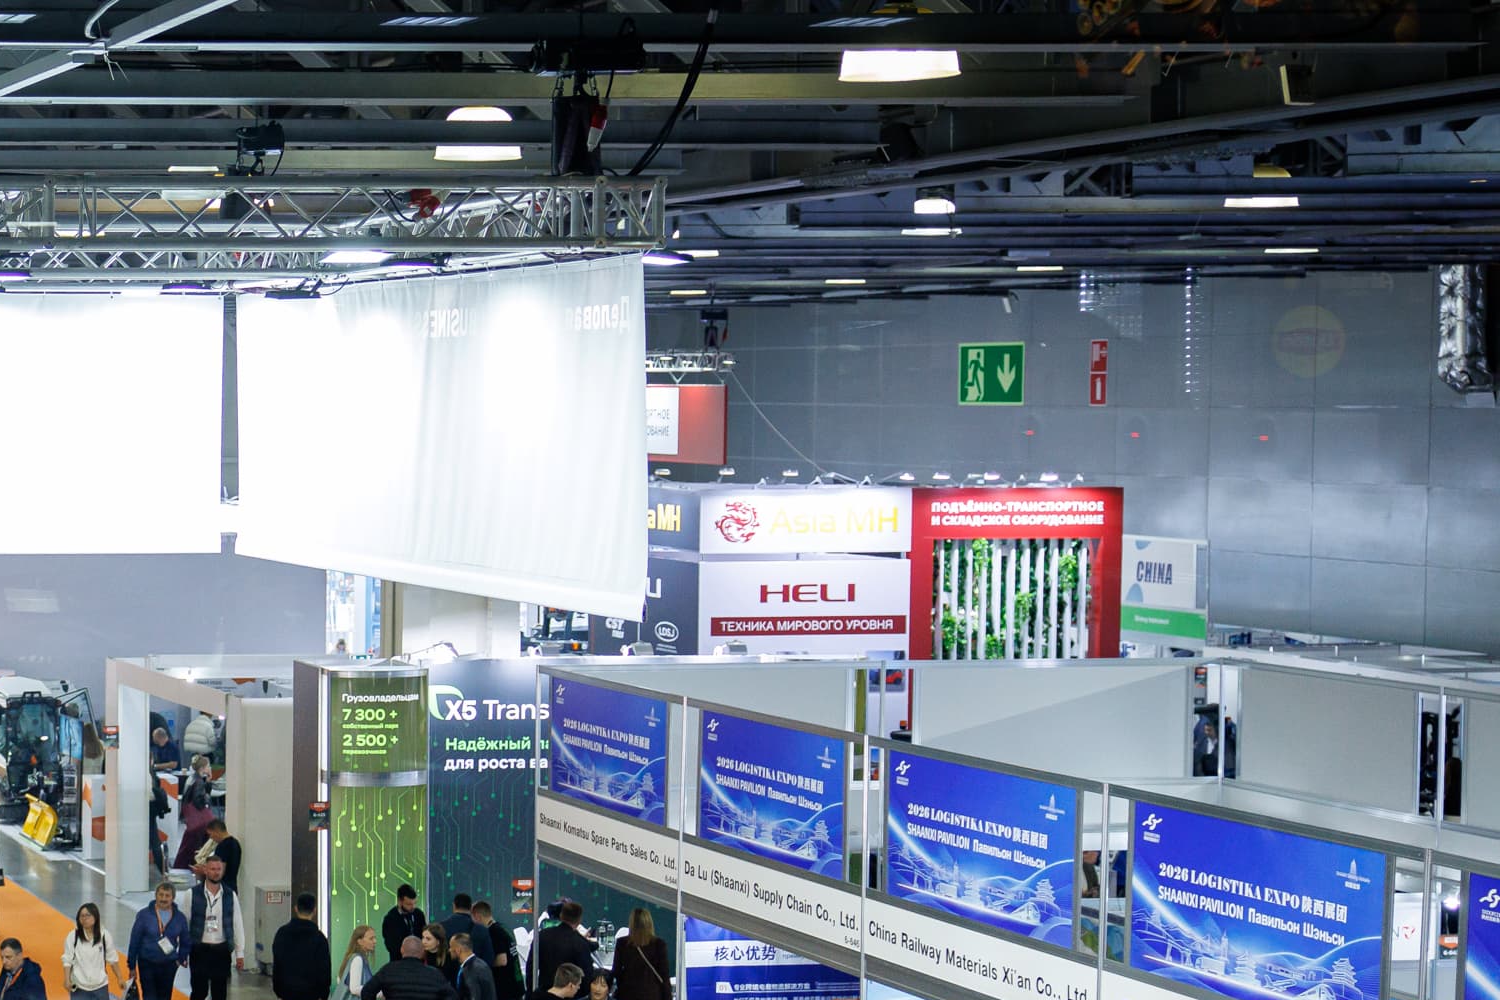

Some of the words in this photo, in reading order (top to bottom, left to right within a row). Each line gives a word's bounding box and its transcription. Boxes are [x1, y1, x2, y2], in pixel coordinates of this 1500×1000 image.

[931, 500, 1105, 513] ПОДЪЁМНО-ТРАНСПОРТНОЕ
[769, 508, 836, 534] Asia
[848, 506, 899, 533] MH
[931, 515, 940, 525] И
[941, 515, 1011, 527] СКЛАДСКОЕ
[1011, 514, 1105, 526] ОБОРУДОВАНИЕ
[1136, 560, 1173, 585] CHINA
[759, 583, 856, 604] HELI
[720, 621, 774, 632] ТЕХНИКА
[776, 620, 843, 632] МИРОВОГО
[846, 619, 894, 631] УРОВНЯ
[342, 708, 350, 720] 7
[355, 708, 386, 721] 300
[444, 700, 477, 721] X5
[343, 734, 352, 746] 2
[355, 734, 387, 747] 500
[445, 736, 531, 752] Надёжный
[444, 758, 474, 771] для
[478, 758, 526, 772] роста
[716, 756, 734, 769] 2026
[736, 759, 775, 781] LOGISTIKA
[777, 769, 796, 785] EXPO
[716, 774, 741, 790] SHAANXI
[741, 779, 765, 796] PAVILION
[767, 788, 796, 805] Павильон
[799, 795, 822, 812] Шэньси
[908, 803, 929, 819] 2026
[931, 808, 983, 832] LOGISTIKA
[985, 821, 1011, 839] EXPO
[539, 812, 562, 830] Shaanxi
[563, 819, 590, 840] Komatsu
[591, 827, 609, 848] Spare
[611, 833, 628, 852] Parts
[630, 840, 648, 861] Sales
[650, 849, 661, 867] Co.
[663, 853, 677, 871] Ltd.
[908, 822, 936, 841] SHAANXI
[938, 830, 969, 850] PAVILION
[973, 839, 1011, 860] Павильон
[1014, 850, 1045, 868] Шэньси
[684, 860, 696, 877] Da
[698, 864, 708, 881] Lu
[710, 868, 750, 898] (Shaanxi)
[753, 882, 783, 909] Supply
[786, 895, 812, 917] Chain
[840, 909, 859, 931] Ltd.
[1159, 862, 1188, 881] 2026
[1191, 869, 1261, 901] LOGISTIKA
[1265, 886, 1299, 908] EXPO
[1301, 895, 1347, 924] 陕西展团
[1158, 885, 1198, 908] SHAANXI
[1200, 894, 1243, 921] PAVILION
[1248, 907, 1299, 935] Павильон
[1303, 921, 1345, 946] Шэньси
[714, 945, 776, 961] 核心优势
[868, 920, 897, 945] China
[901, 932, 941, 959] Railway
[945, 949, 998, 981] Materials
[1002, 966, 1031, 992] Xi'an
